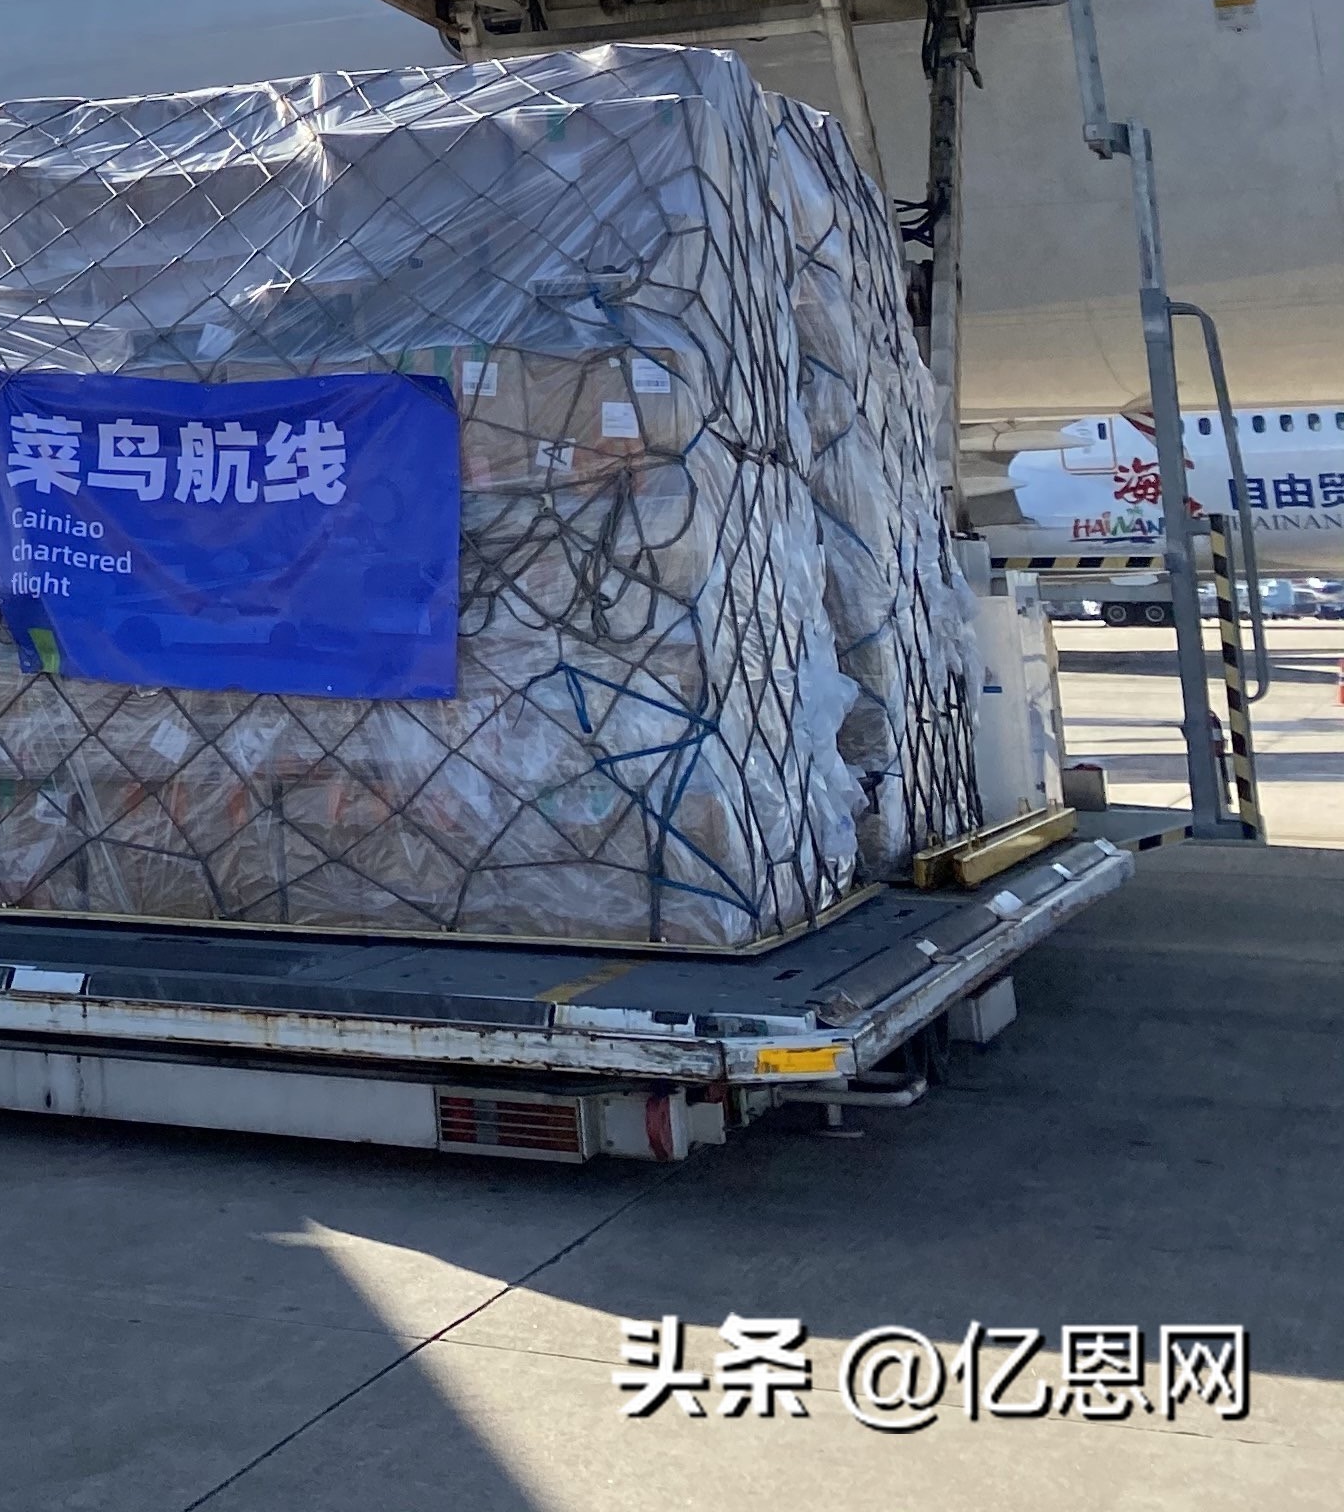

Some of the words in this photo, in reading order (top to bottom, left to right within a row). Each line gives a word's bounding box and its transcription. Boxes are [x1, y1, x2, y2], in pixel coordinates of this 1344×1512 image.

[6, 412, 348, 506] 菜鸟航线
[11, 506, 105, 539] Cainiao
[11, 538, 132, 575] chartered
[11, 570, 72, 600] flight
